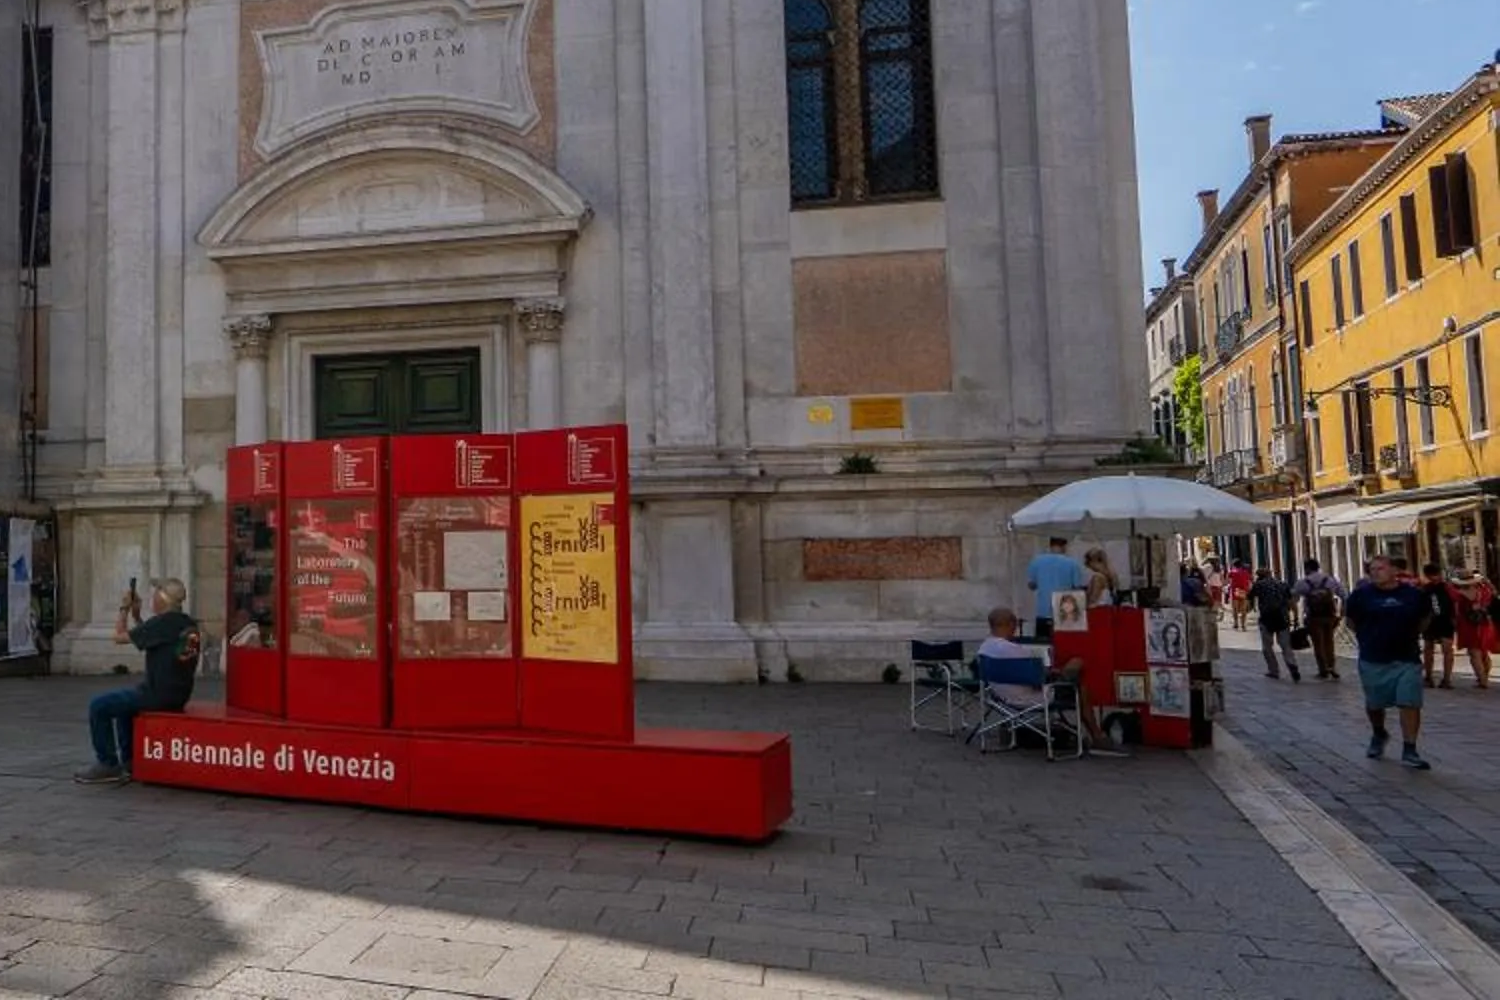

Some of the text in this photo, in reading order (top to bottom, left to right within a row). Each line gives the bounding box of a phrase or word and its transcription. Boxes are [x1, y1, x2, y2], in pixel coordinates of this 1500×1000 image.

[143, 736, 395, 781] La Biennale di Venezia
